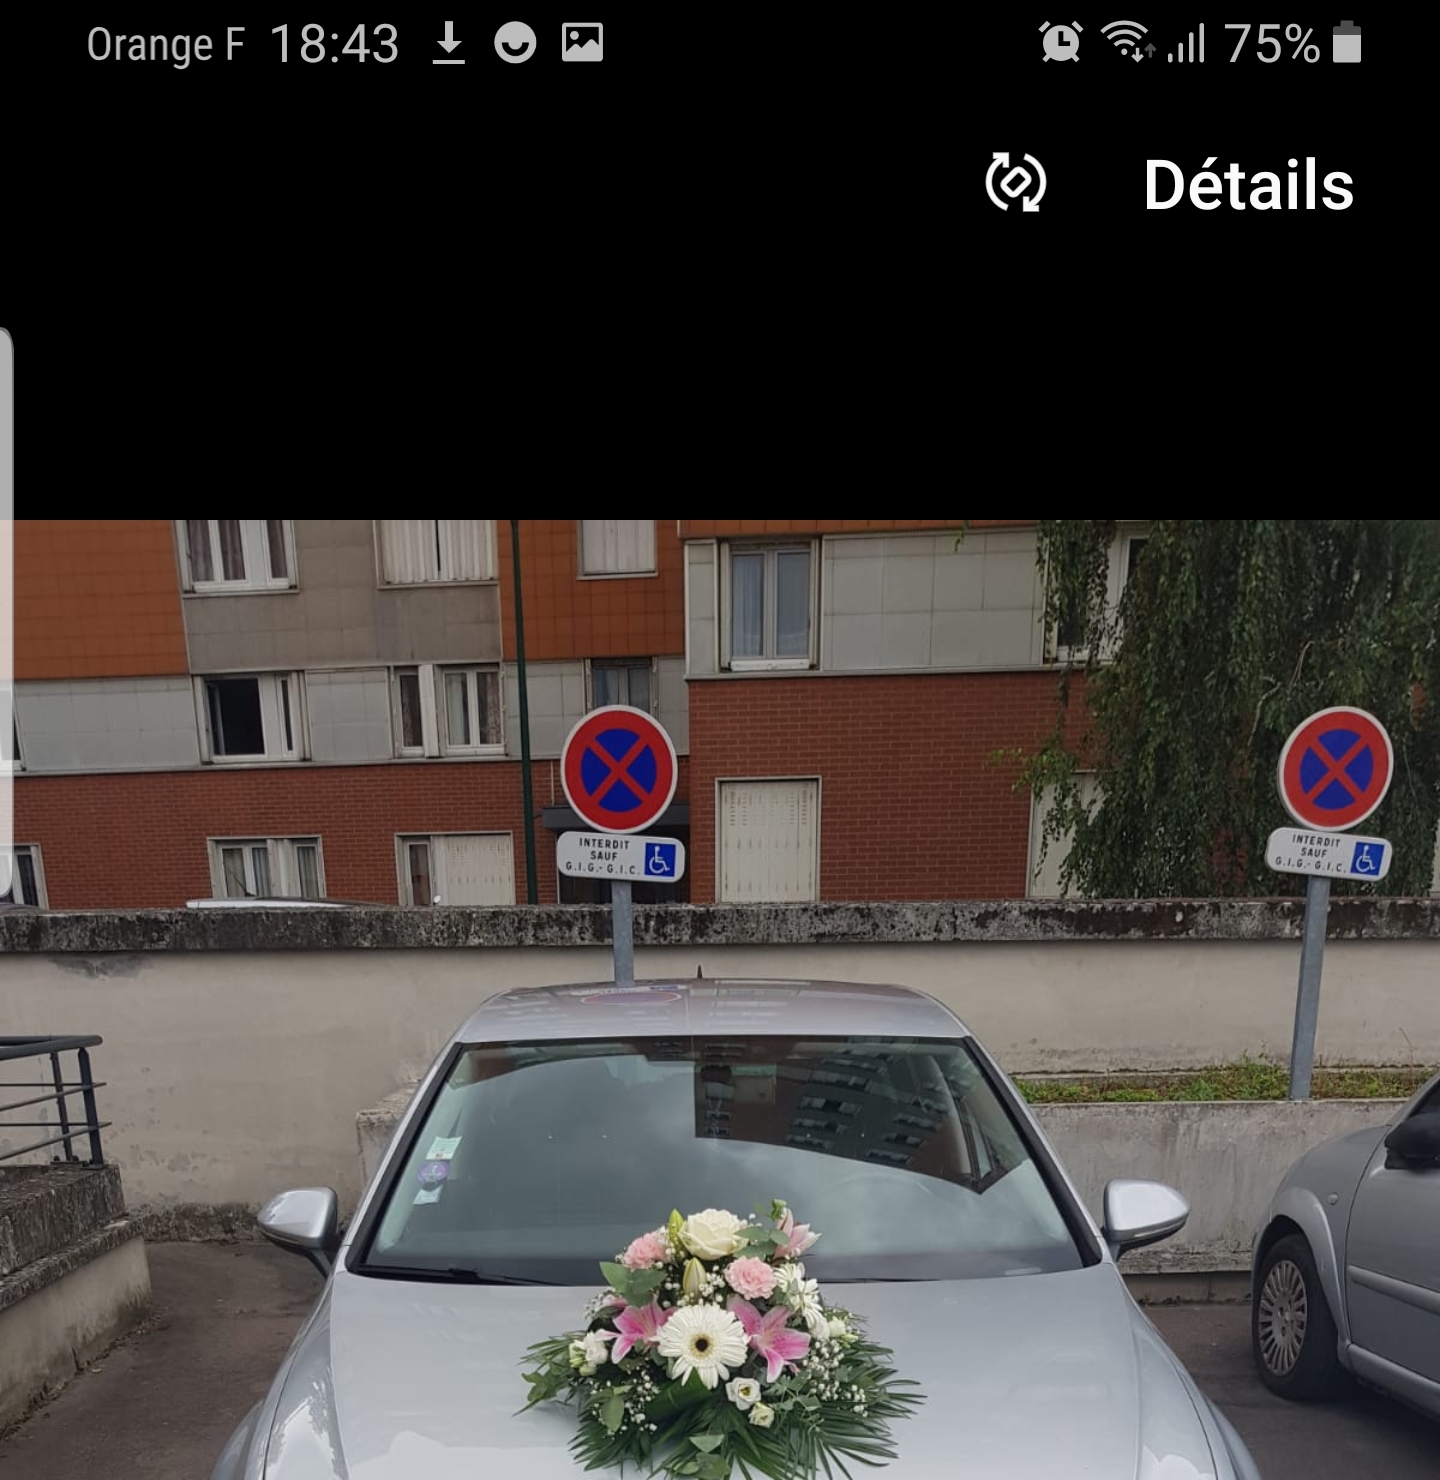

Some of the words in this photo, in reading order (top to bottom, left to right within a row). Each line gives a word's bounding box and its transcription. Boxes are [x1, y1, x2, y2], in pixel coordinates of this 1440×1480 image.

[579, 838, 630, 850] INTERDIT
[1292, 834, 1341, 847] INTERDIT
[590, 850, 618, 861] SAUF
[1300, 847, 1328, 858] SAUF
